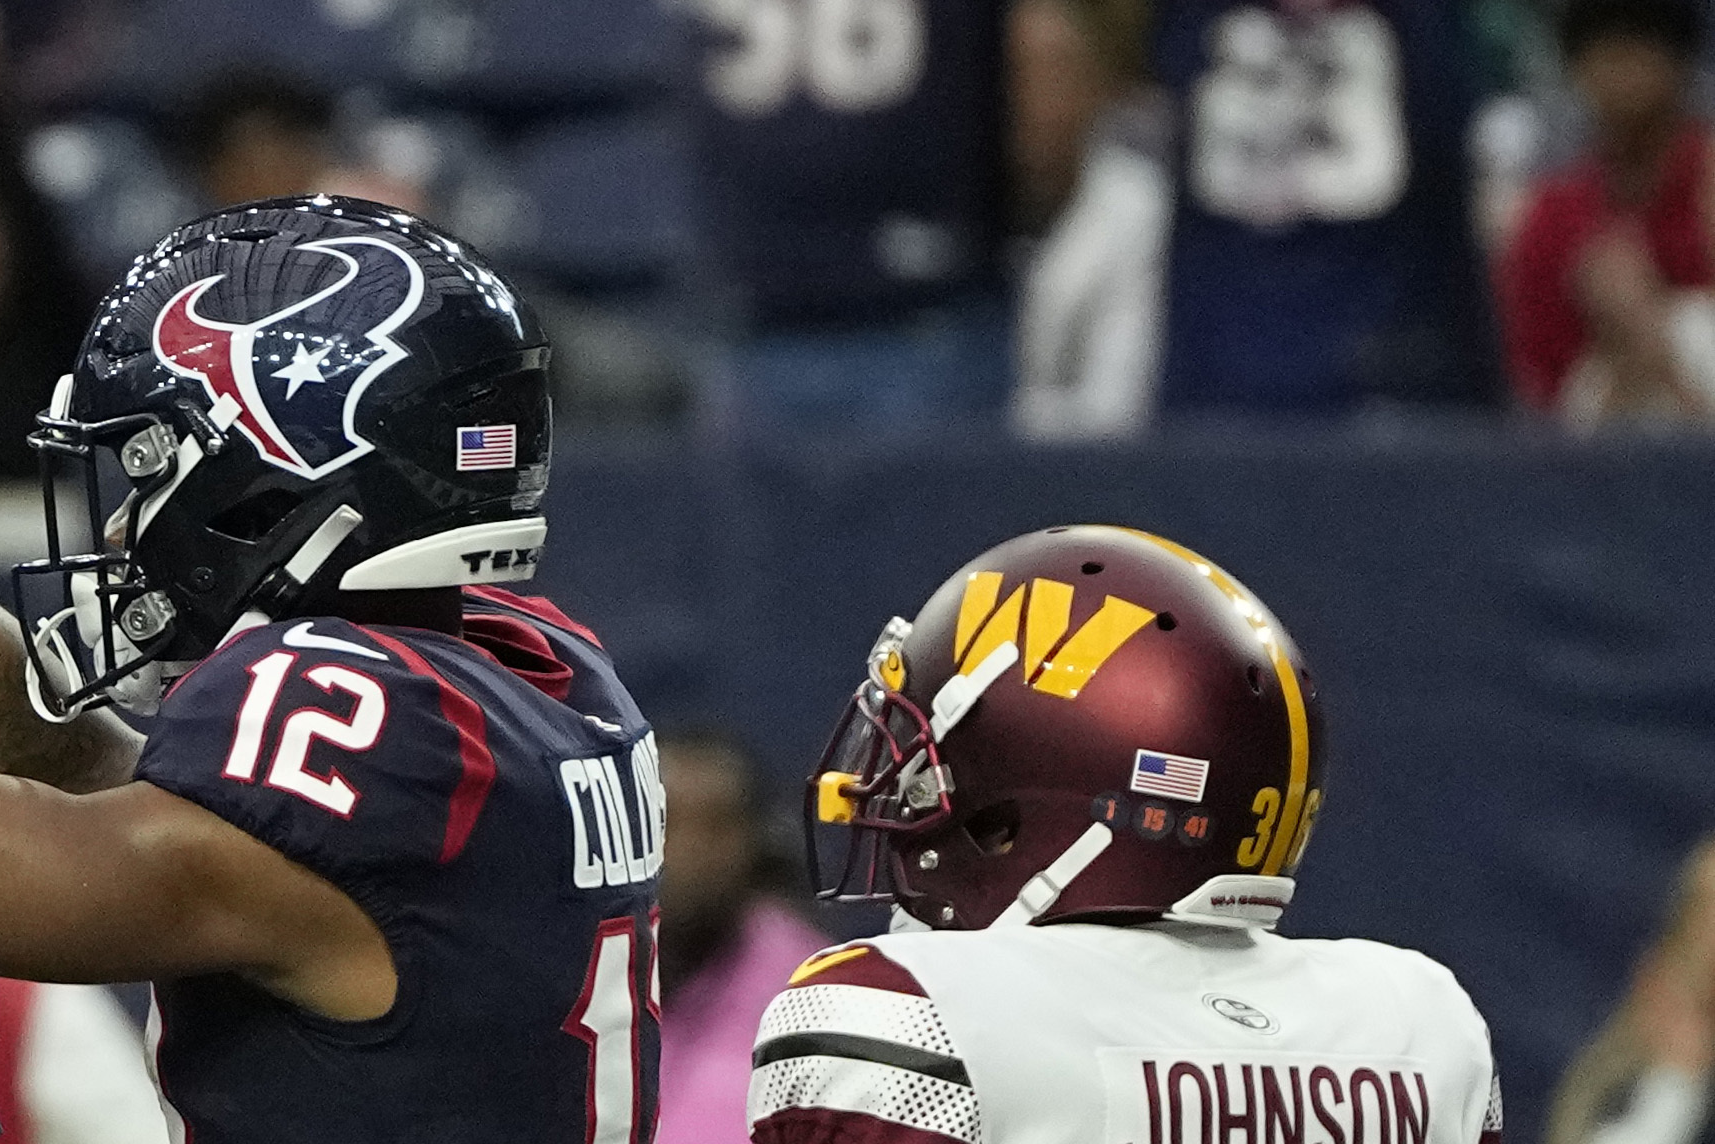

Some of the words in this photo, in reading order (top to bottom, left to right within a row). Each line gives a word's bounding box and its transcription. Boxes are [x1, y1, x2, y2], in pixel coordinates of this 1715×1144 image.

[460, 548, 539, 575] TEX
[221, 649, 391, 822] 12
[1105, 799, 1116, 821] 1
[1142, 806, 1166, 832] 15
[1183, 815, 1209, 839] 41
